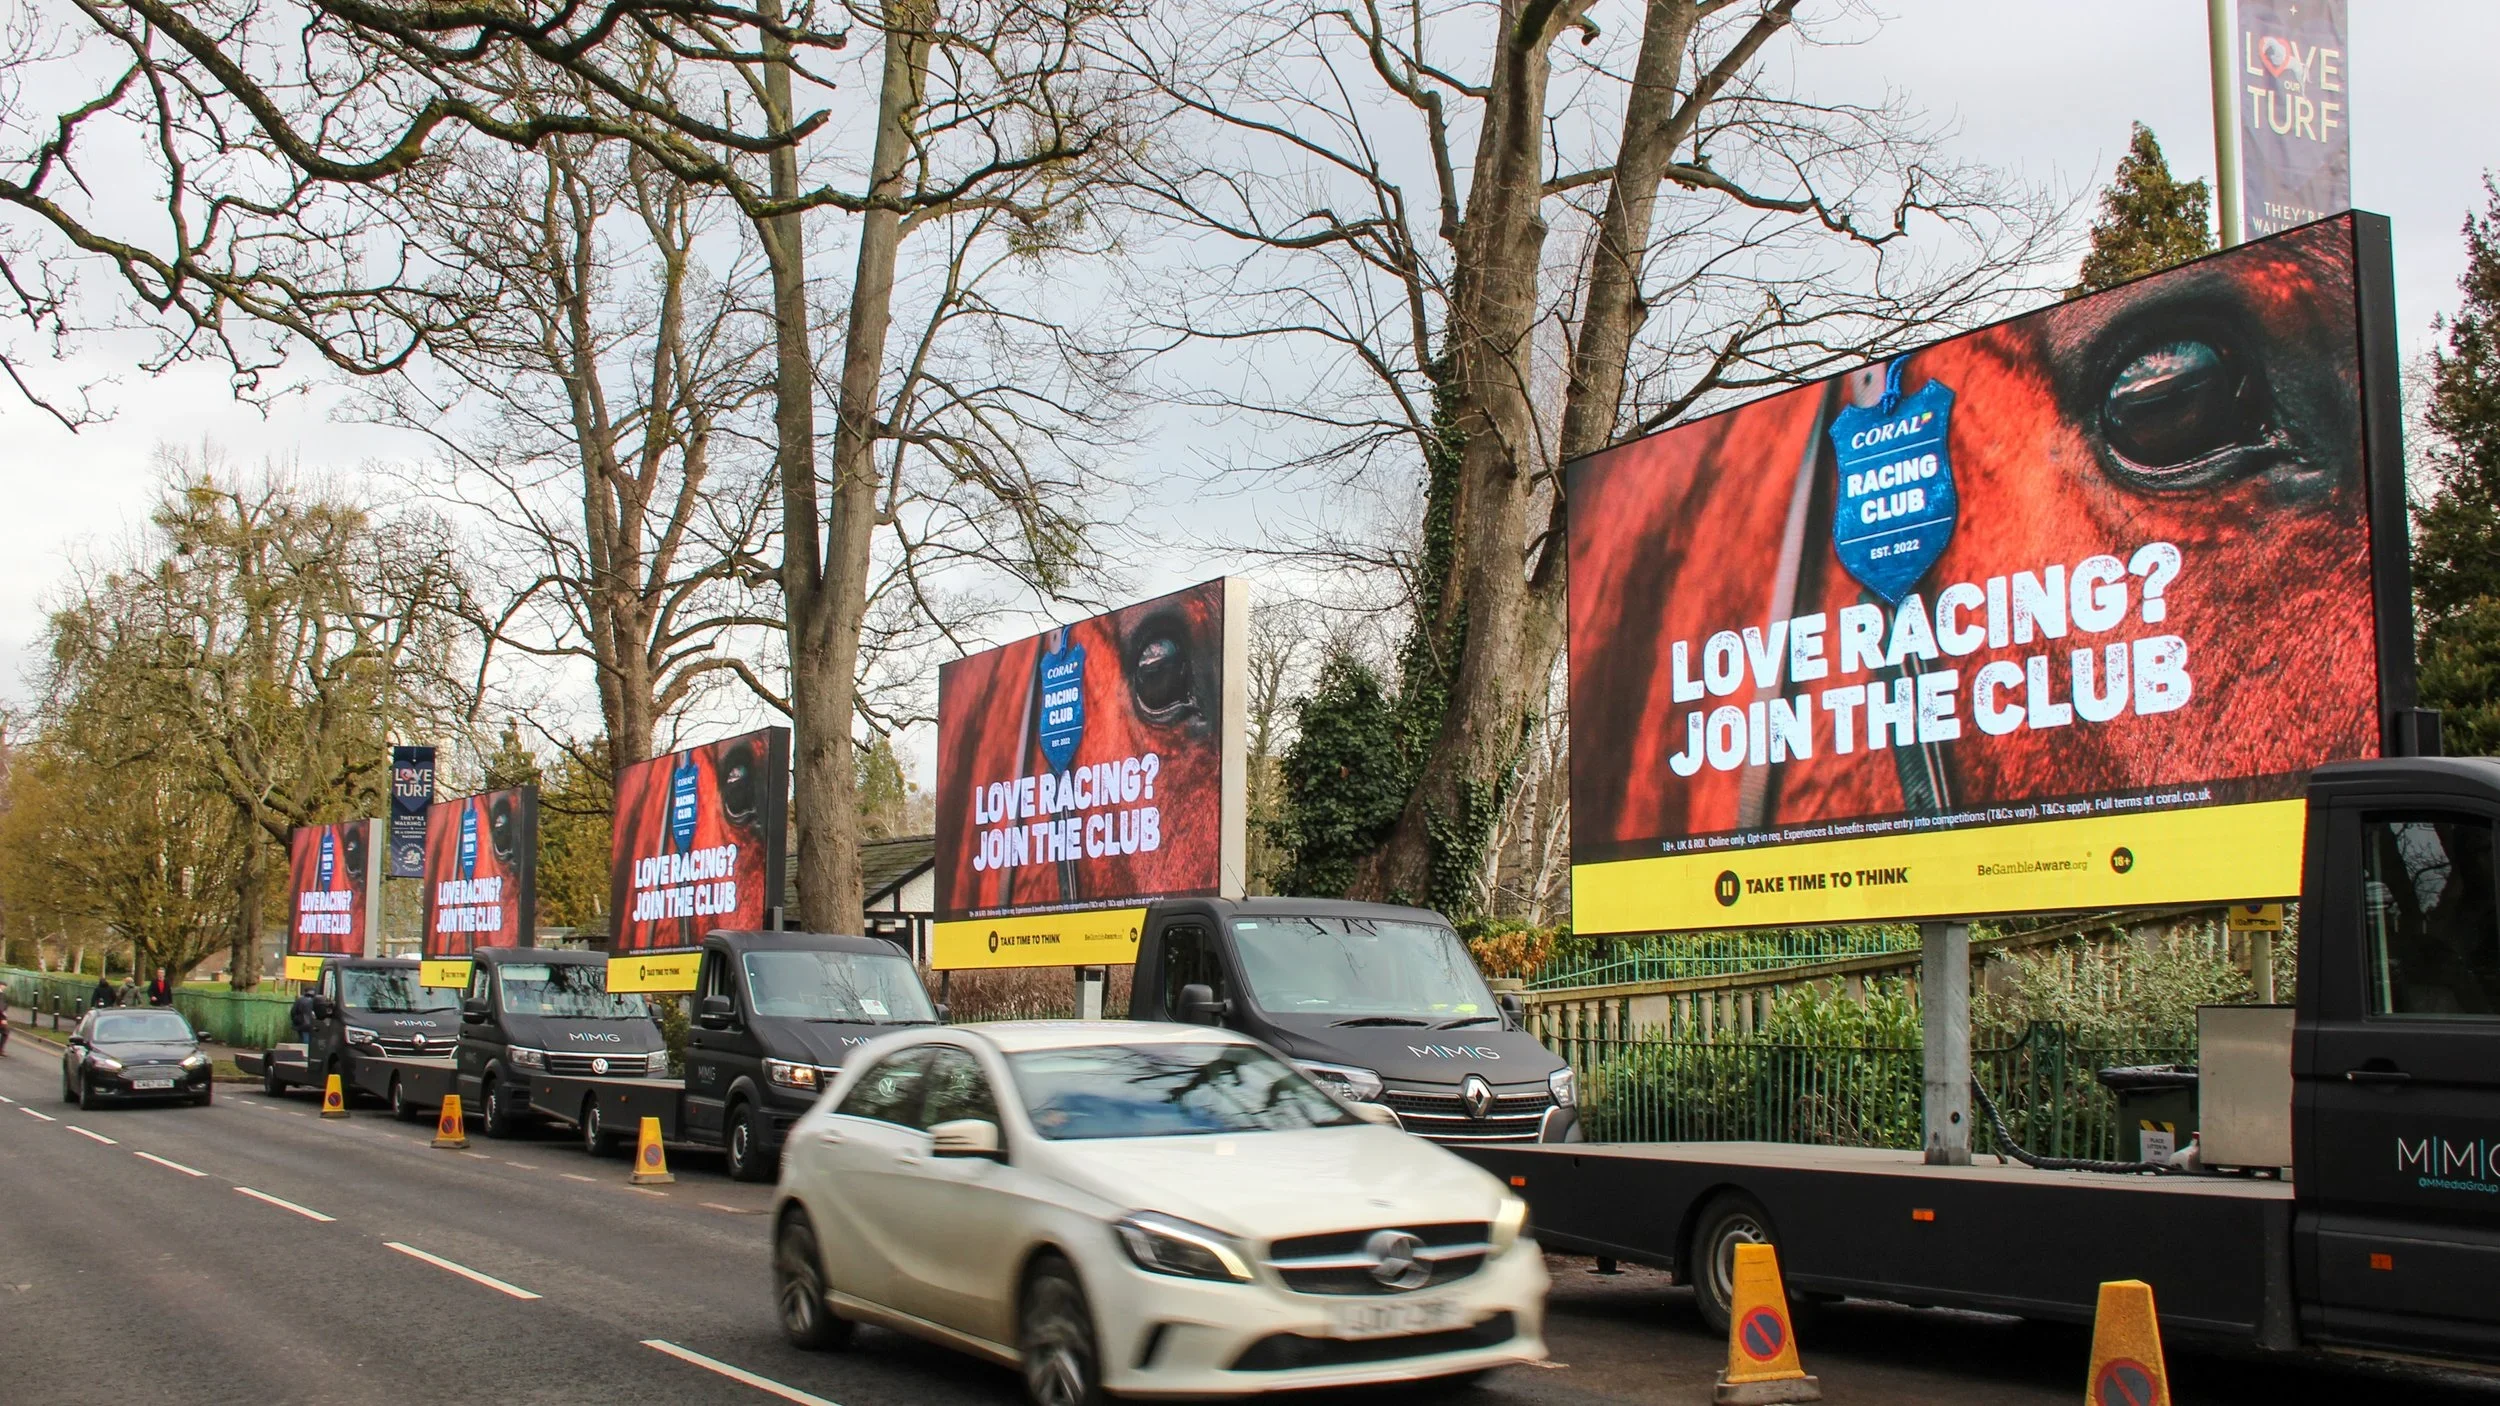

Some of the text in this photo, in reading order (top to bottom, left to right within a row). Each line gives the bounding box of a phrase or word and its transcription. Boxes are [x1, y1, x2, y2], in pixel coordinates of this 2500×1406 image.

[2245, 31, 2341, 92] LOVE
[2247, 84, 2340, 143] TURF
[1851, 416, 1922, 450] CORAL
[1847, 454, 1937, 498] RACING
[1860, 488, 1925, 524] CLUB
[1870, 539, 1920, 560] EST. 2022
[1671, 540, 2183, 704] LOVE RACING?
[1047, 662, 1074, 680] CORAL
[1044, 687, 1079, 708] RACING
[1668, 633, 2193, 778] JOIN THE CLUB
[1049, 706, 1074, 726] CLUB
[394, 783, 432, 798] TURF
[395, 767, 432, 783] LOVE
[975, 753, 1160, 825] LOVE RACING?
[1676, 840, 1687, 850] UK
[1708, 835, 1730, 848] Online
[1747, 832, 1768, 845] Opt-in
[1768, 831, 1783, 843] req.
[1783, 827, 1827, 842] Experiences
[1827, 825, 1834, 835] &
[1834, 820, 1864, 836] benefits
[1865, 819, 1892, 834] require
[1893, 817, 1914, 831] entry
[1914, 815, 1931, 828] into
[1931, 811, 1985, 828] competitions
[1986, 807, 2013, 823] (T&Cs
[2014, 804, 2039, 820] vary).
[2040, 802, 2065, 816] T&Cs
[2066, 800, 2093, 814] apply.
[2095, 797, 2112, 810] Full
[2114, 795, 2142, 809] terms
[2143, 794, 2154, 806] at
[2155, 788, 2212, 804] coral.co.uk
[973, 807, 1161, 872] JOIN THE CLUB
[635, 843, 737, 889] LOVE RACING?
[1977, 859, 2088, 877] BeGambleAware.org
[2112, 855, 2131, 867] 18+
[438, 875, 502, 906] LOVE RACING?
[1745, 867, 1908, 895] TAKE TIME TO THINK
[632, 881, 736, 922] JOIN THE CLUB
[317, 913, 331, 934] THE
[331, 913, 352, 935] CLUB
[436, 905, 502, 933] JOIN THE CLUB
[1000, 933, 1060, 947] TAKE TIME TO THINK
